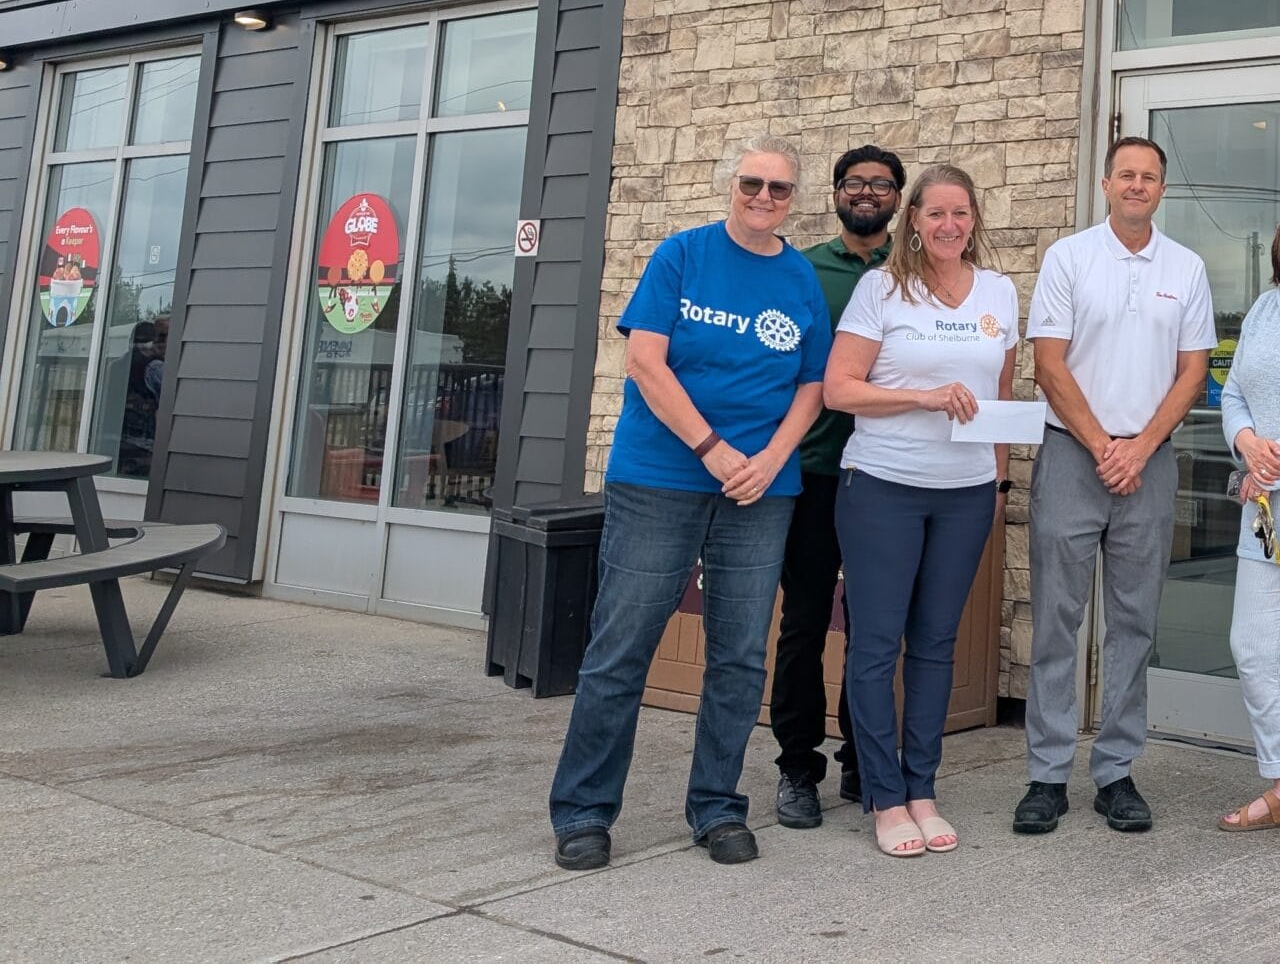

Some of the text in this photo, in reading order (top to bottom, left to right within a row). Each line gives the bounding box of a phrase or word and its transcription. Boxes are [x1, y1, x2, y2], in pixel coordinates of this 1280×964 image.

[56, 226, 70, 236] Every
[345, 216, 379, 234] GLOBE
[680, 298, 750, 334] Rotary
[935, 320, 977, 333] Rotary
[906, 332, 981, 342] Club of Shelburne
